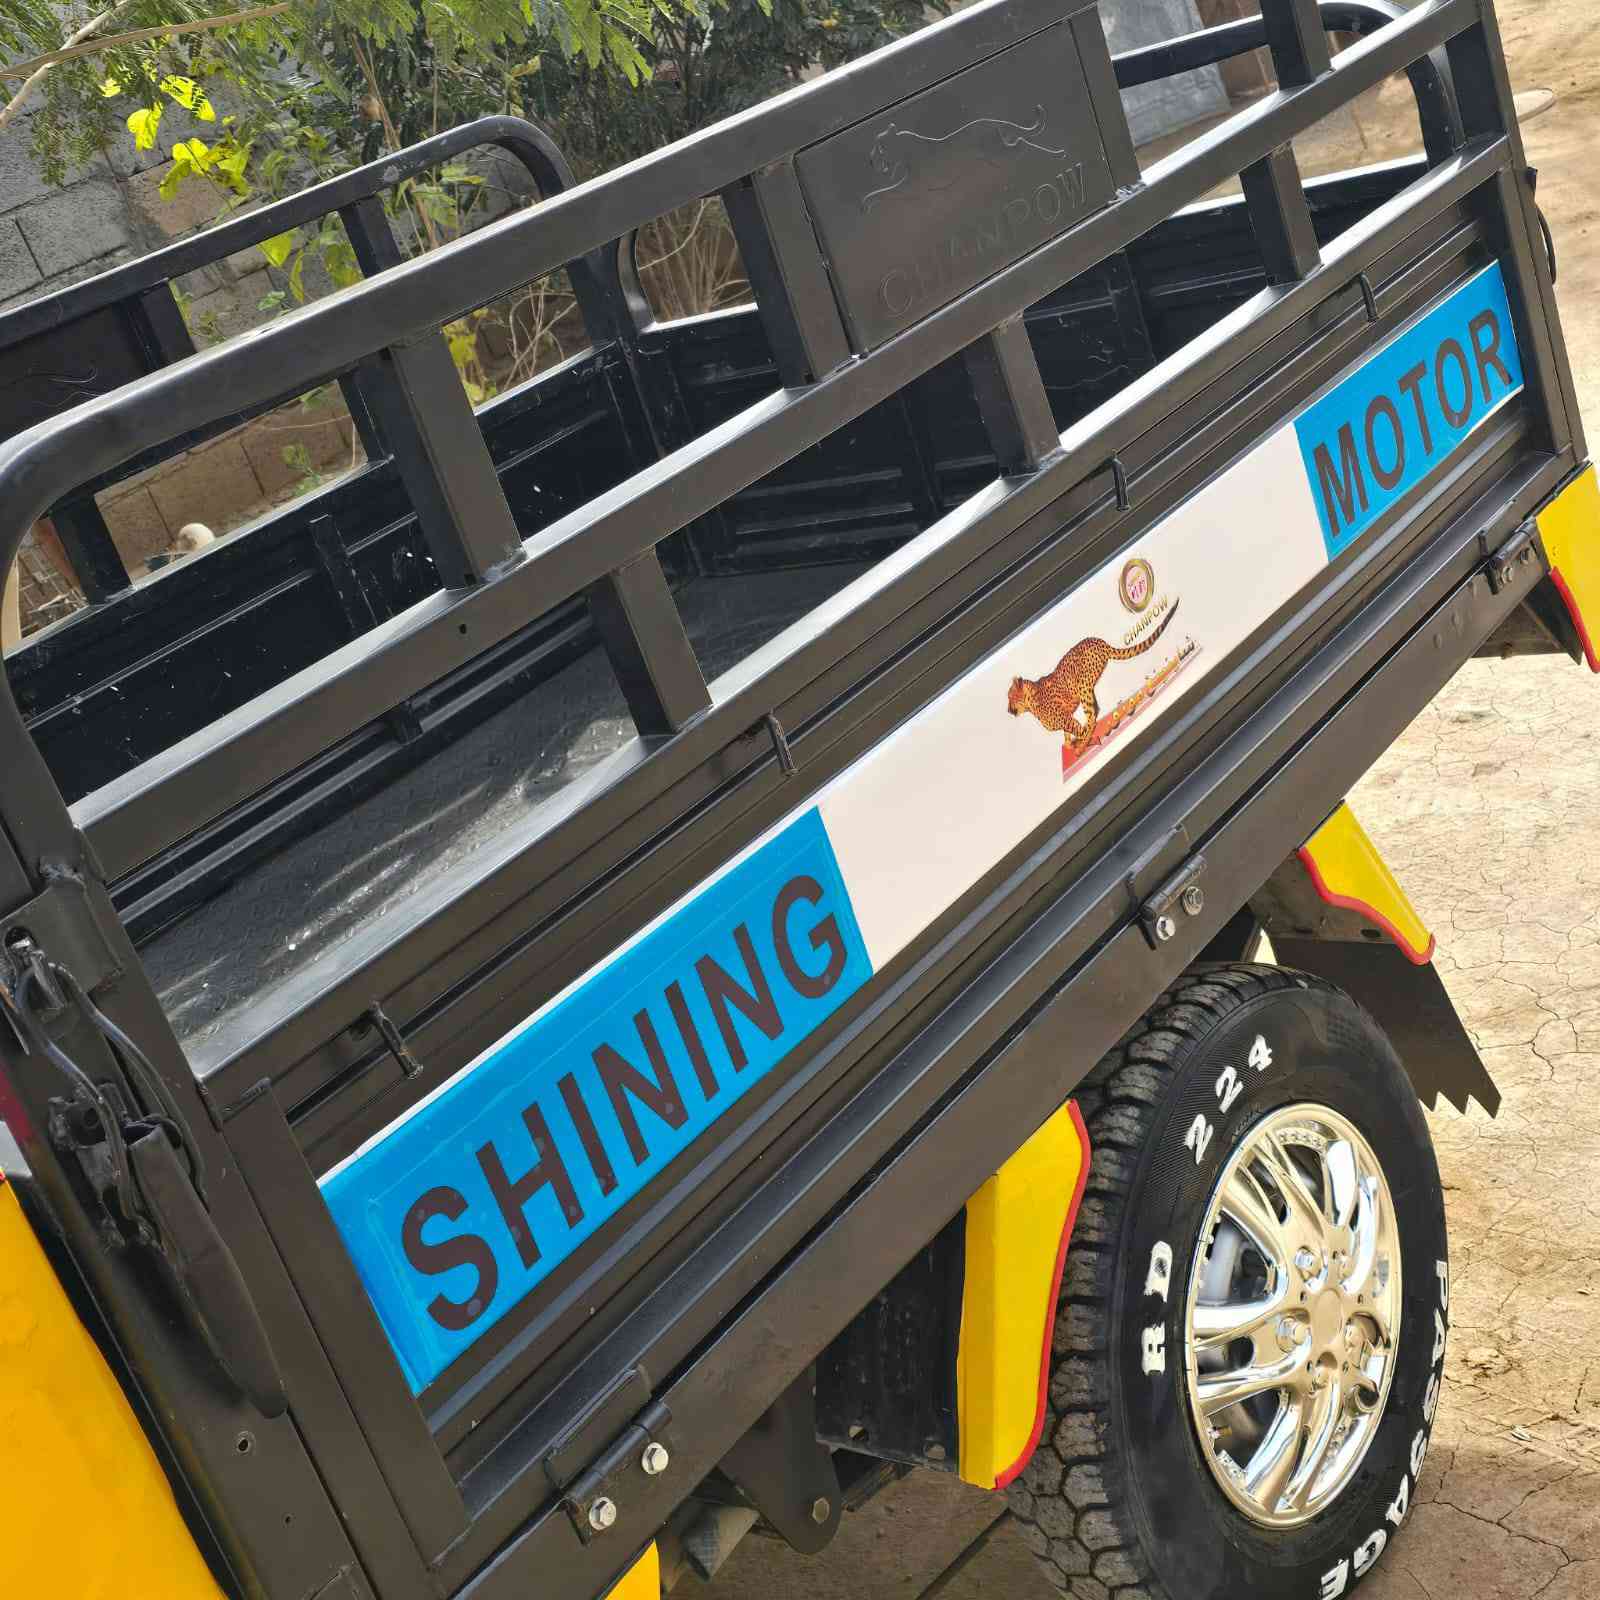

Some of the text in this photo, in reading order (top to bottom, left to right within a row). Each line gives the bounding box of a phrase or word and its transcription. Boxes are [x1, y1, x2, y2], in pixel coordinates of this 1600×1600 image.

[1123, 595, 1168, 646] CHANPOW
[401, 308, 1513, 1332] SHINING MOTOR
[1318, 1259, 1448, 1600] PASSAGE
